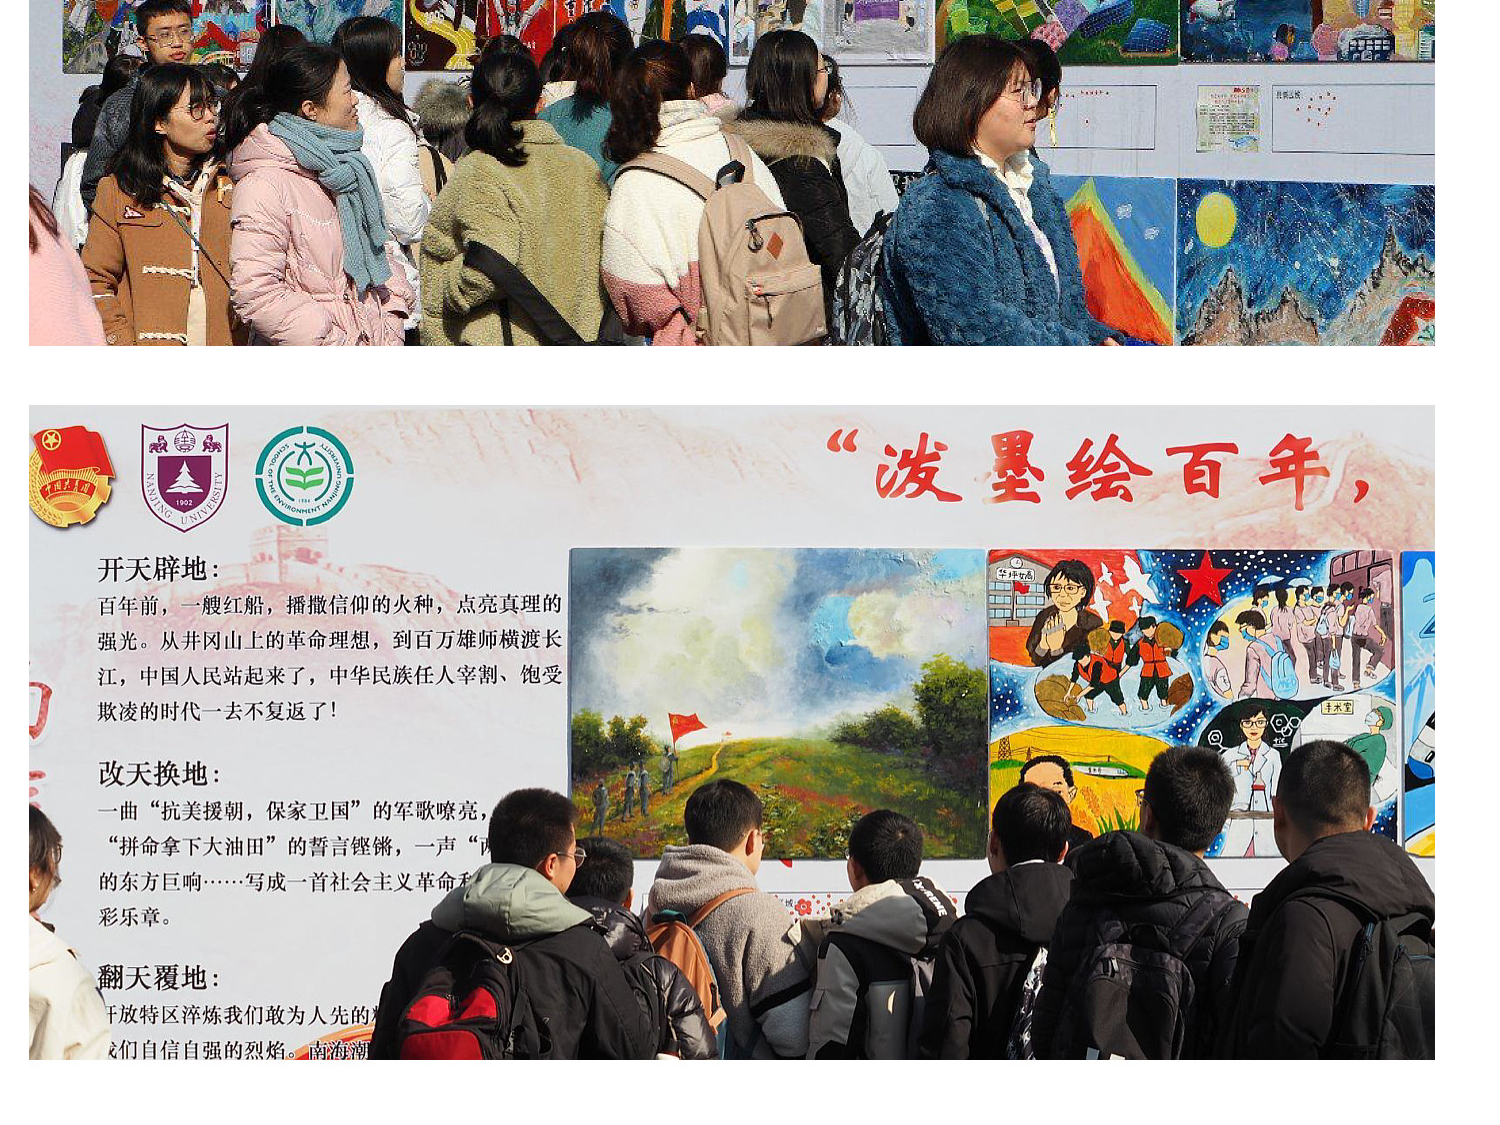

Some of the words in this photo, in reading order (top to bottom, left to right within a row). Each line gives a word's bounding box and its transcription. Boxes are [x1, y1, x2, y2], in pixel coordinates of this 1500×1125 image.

[146, 472, 173, 519] NANJING
[180, 472, 223, 525] UNIVERSITY
[98, 555, 219, 583] 开天辟地：
[98, 594, 562, 617] 百年前，一艘红船，播撒信仰的火种，点亮真理的
[97, 629, 563, 651] 强光。从井冈山上的革命理想，到百万雄师横渡长
[97, 664, 563, 687] 江，中国人民站起来了，中华民族任人宰割、饱受
[97, 700, 336, 723] 欺凌的时代一去不复返了！
[99, 760, 220, 788] 改天换地：
[99, 907, 169, 927] 彩乐章。
[97, 963, 219, 991] 翻天覆地：
